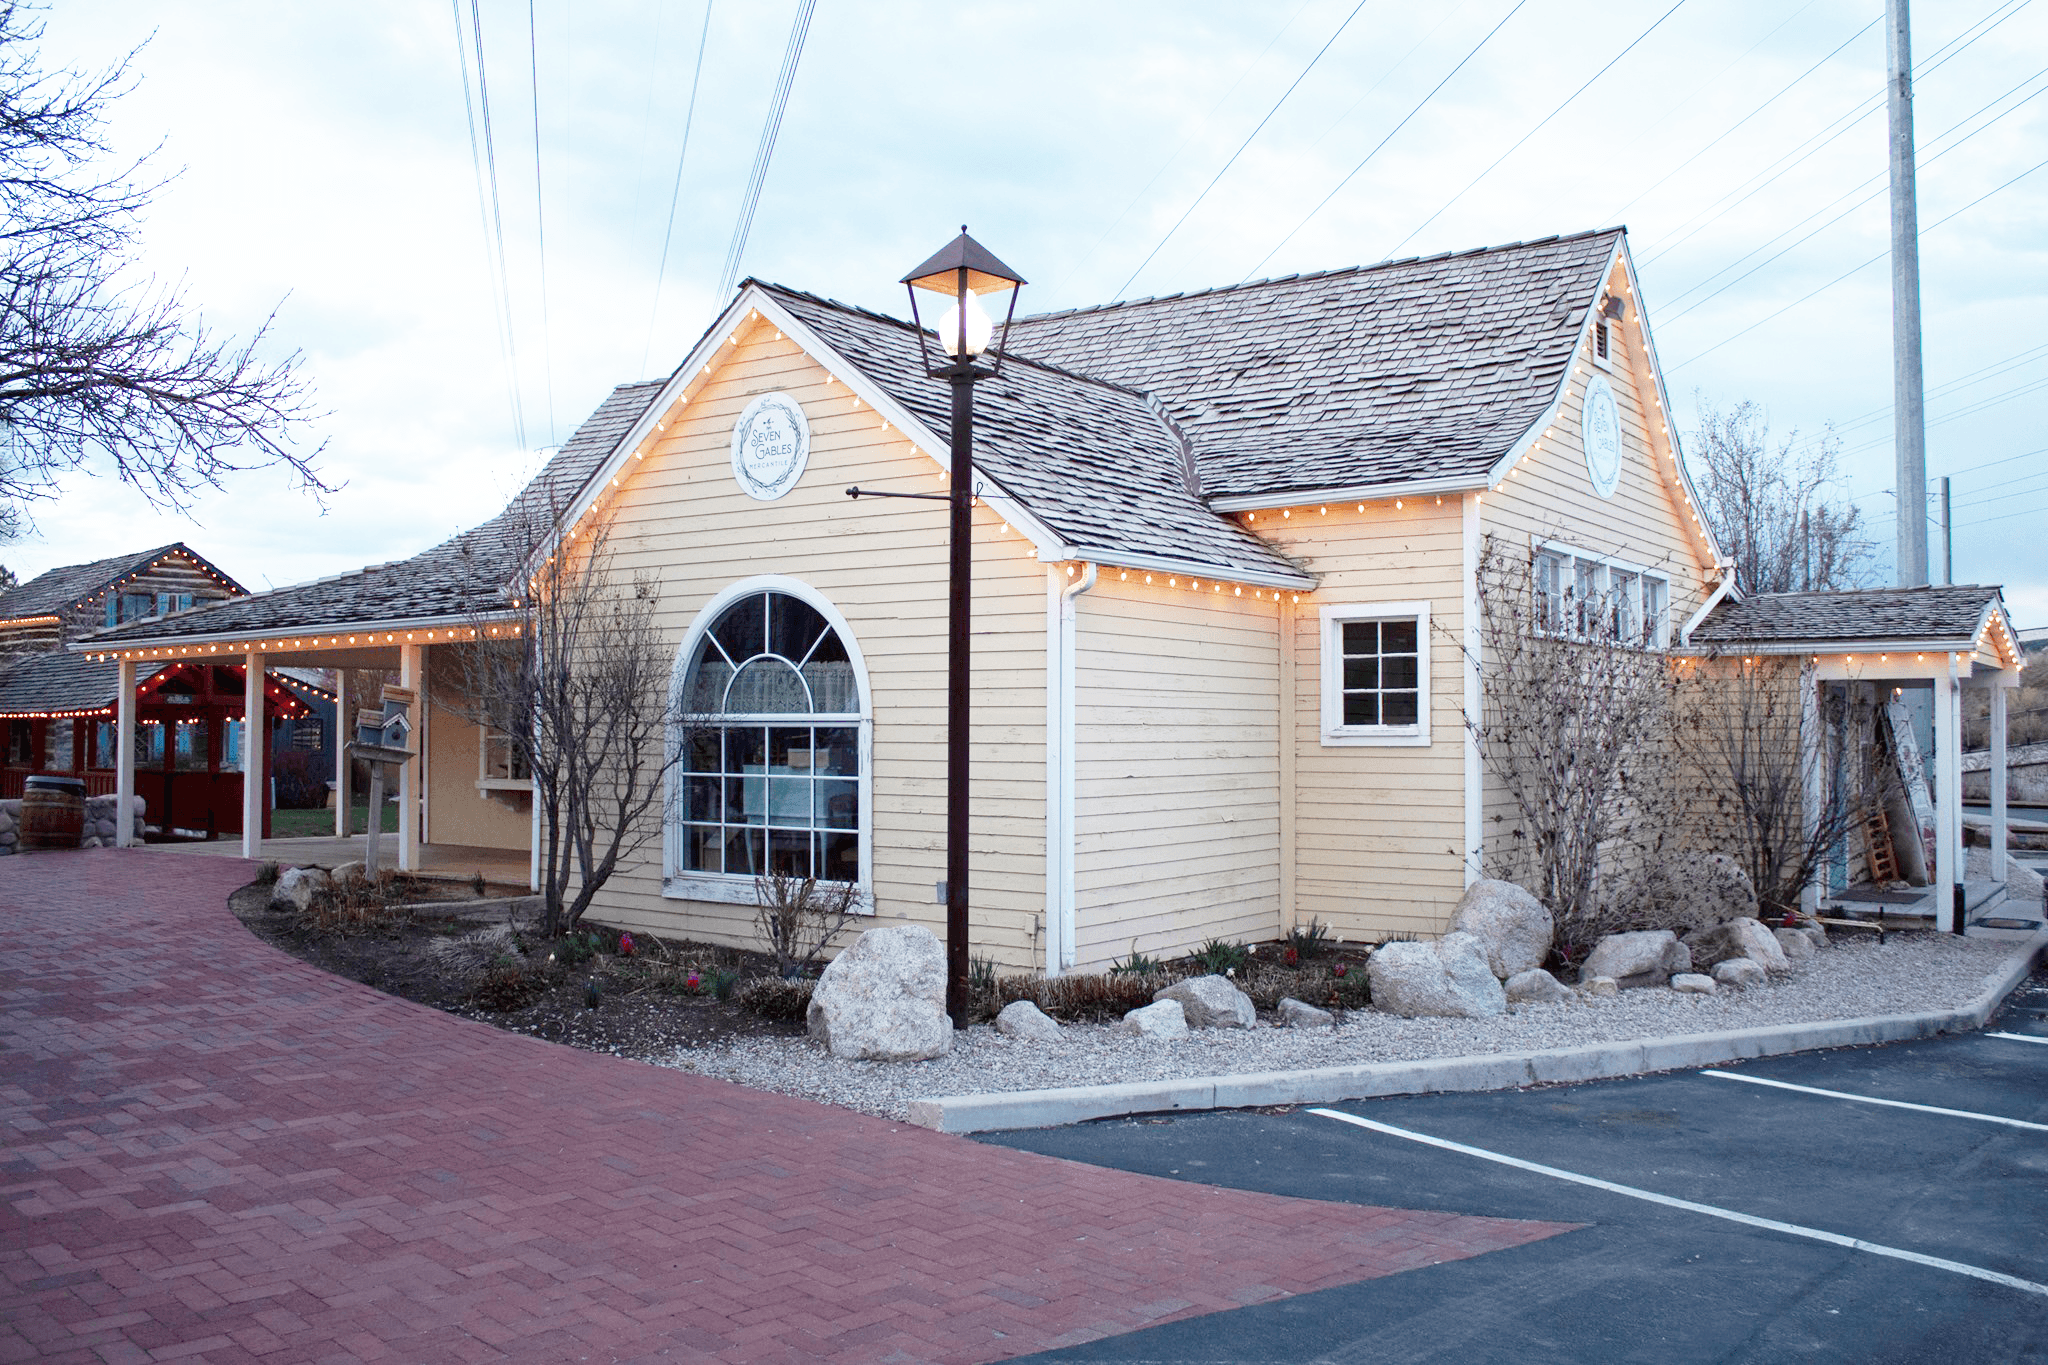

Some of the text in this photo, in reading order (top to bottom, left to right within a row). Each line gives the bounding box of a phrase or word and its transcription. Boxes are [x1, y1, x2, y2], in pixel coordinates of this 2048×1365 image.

[751, 429, 781, 447] SEVEN
[755, 443, 792, 460] GABLES
[749, 460, 788, 470] MERCANTILE
